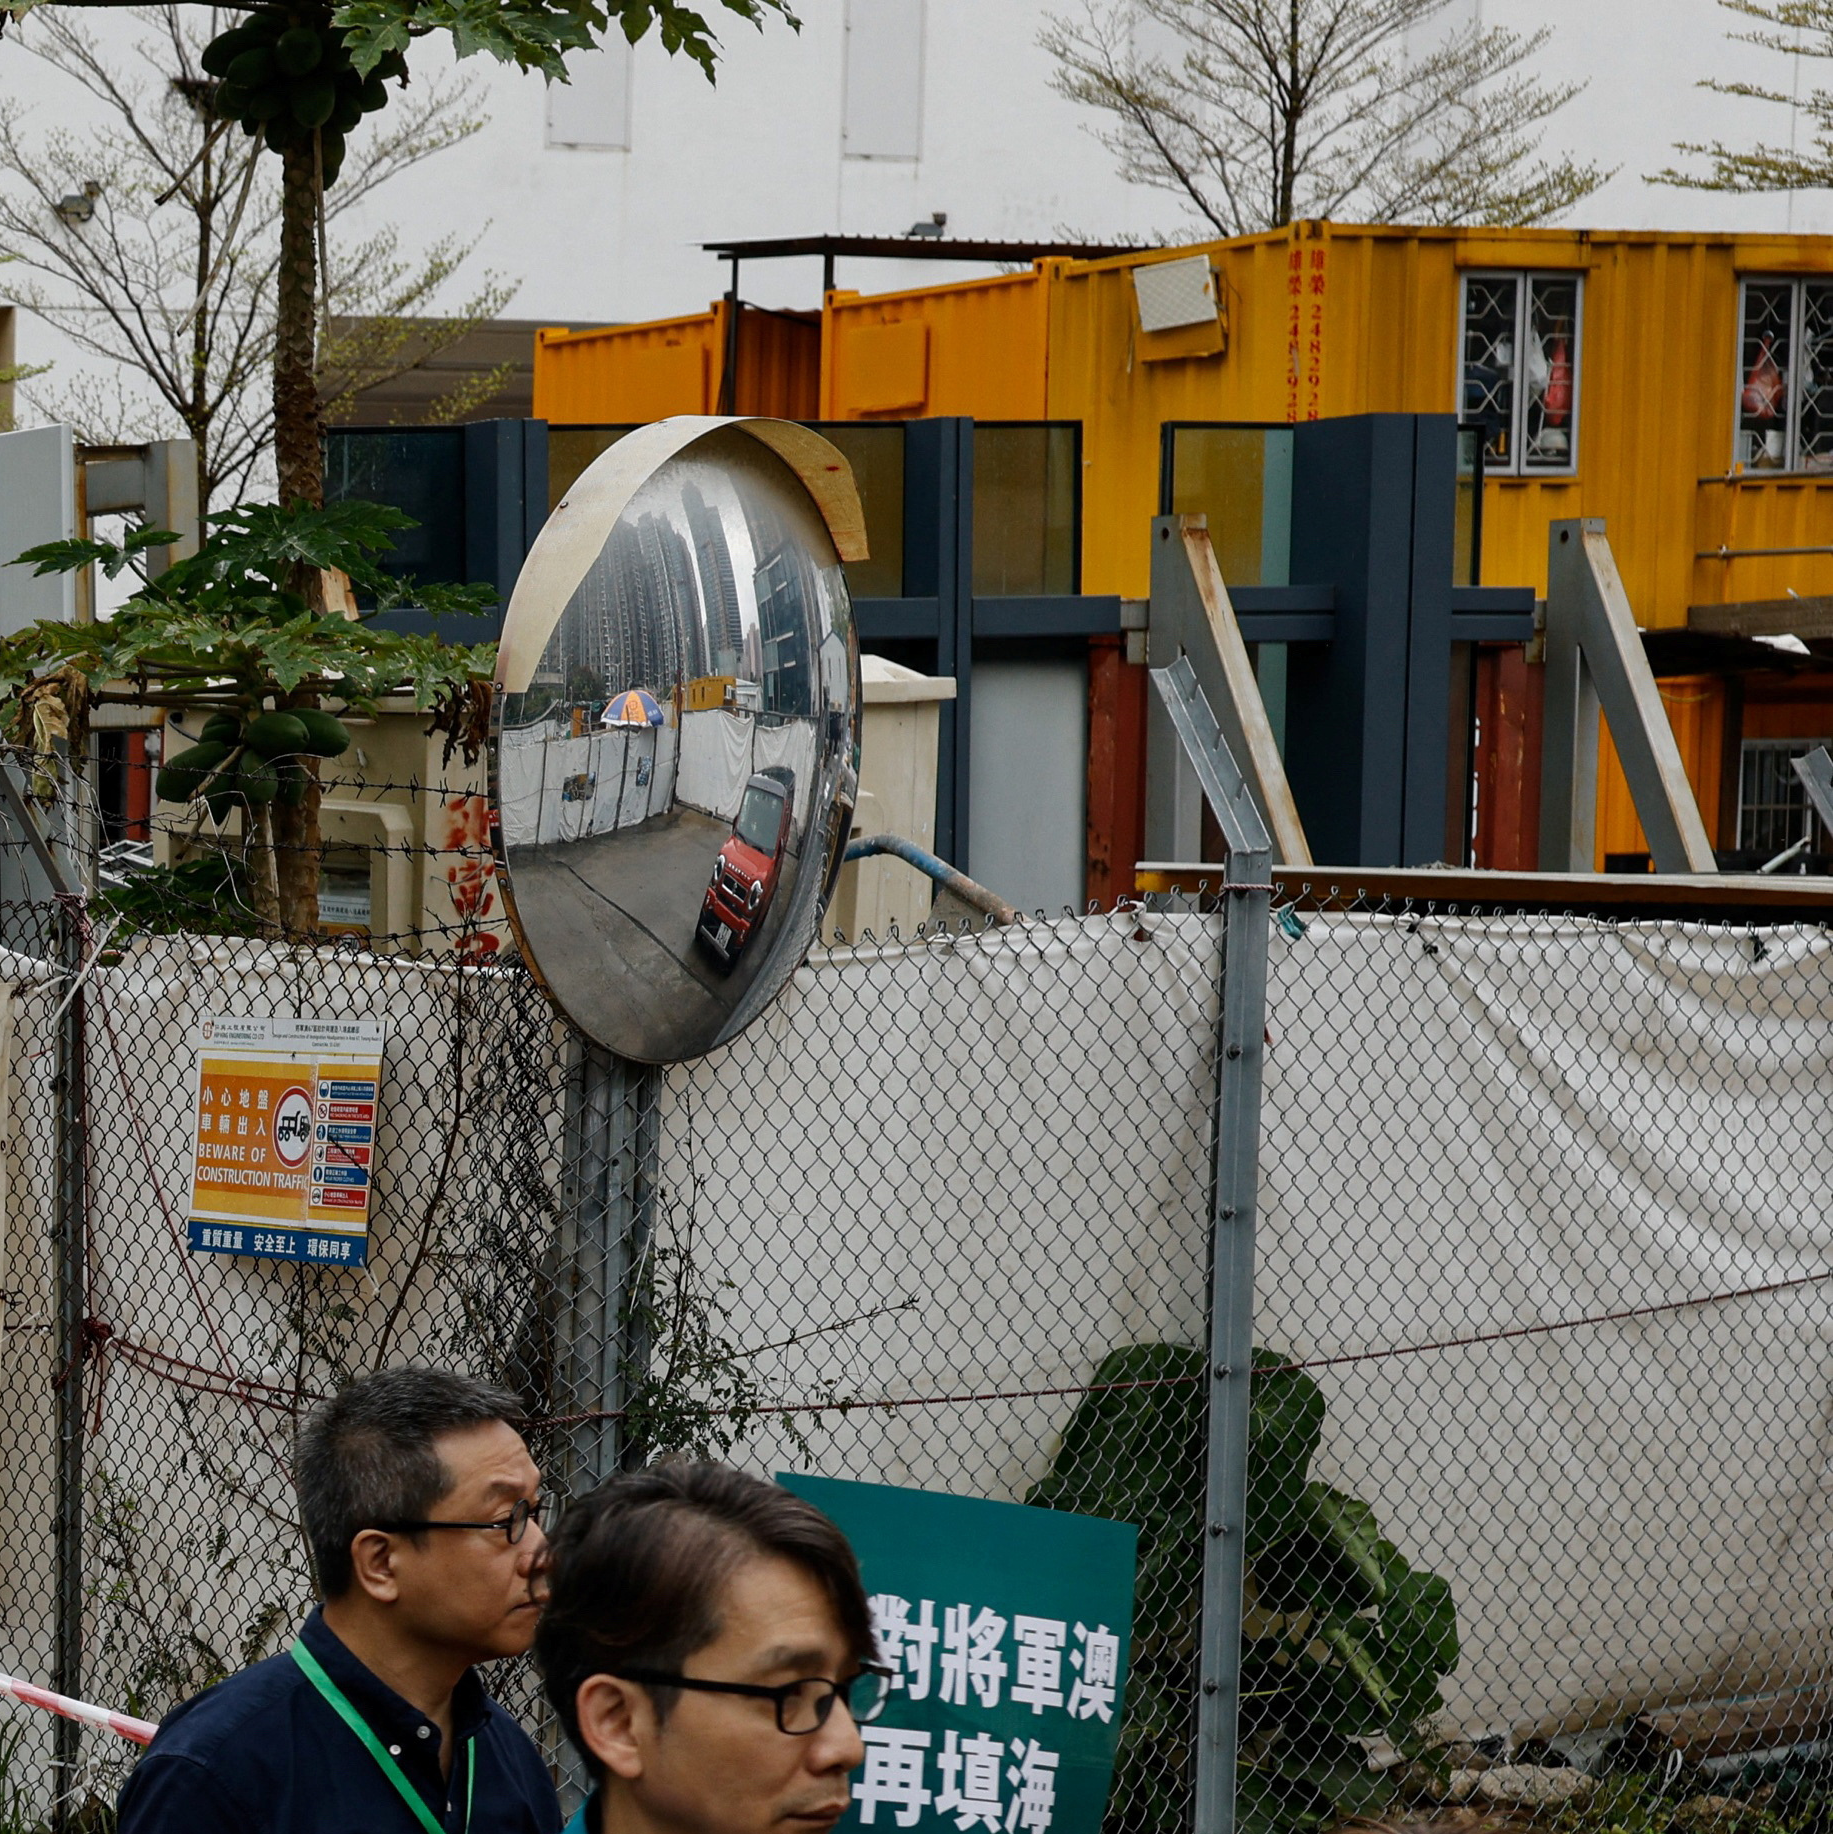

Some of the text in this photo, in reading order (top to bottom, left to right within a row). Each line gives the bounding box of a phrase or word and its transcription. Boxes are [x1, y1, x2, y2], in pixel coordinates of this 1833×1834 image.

[201, 1085, 269, 1110] 小心地盤
[200, 1112, 267, 1136] 車輛出入
[199, 1143, 266, 1163] BEWARE OF
[197, 1165, 270, 1187] CONSTRUCTION
[201, 1228, 351, 1261] 重質重量 安全至上 環保同享
